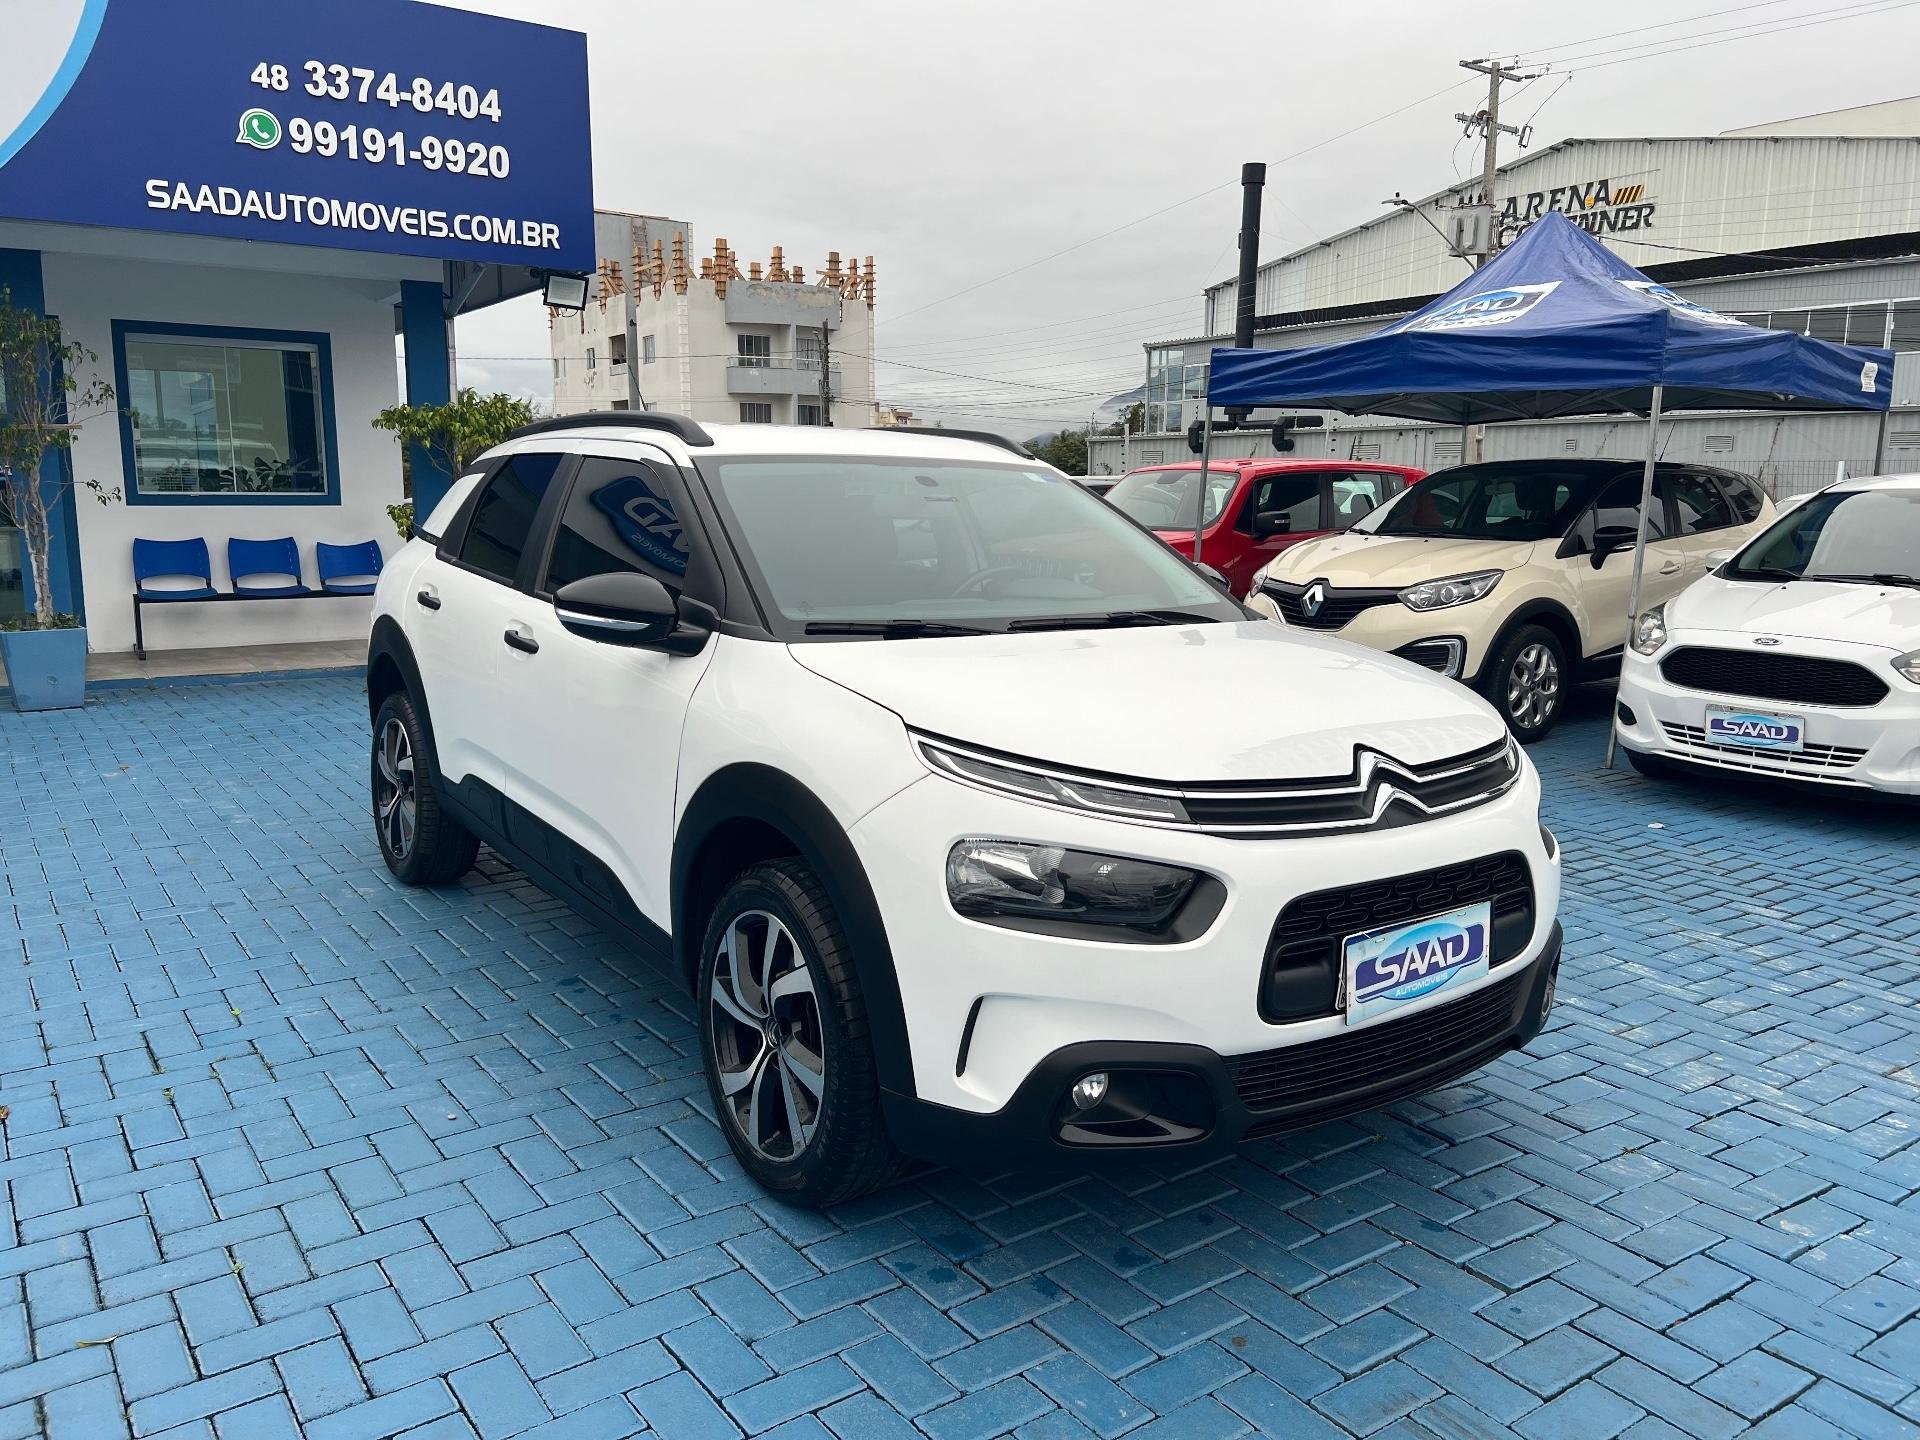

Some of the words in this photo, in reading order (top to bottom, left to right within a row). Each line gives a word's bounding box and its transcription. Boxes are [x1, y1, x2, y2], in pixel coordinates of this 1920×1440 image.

[250, 62, 289, 91] 48
[303, 60, 502, 122] 3374-8404
[288, 117, 510, 179] 99191-9920
[145, 179, 561, 249] SAADAUTOMOVEIS.COM.BR
[1501, 179, 1612, 226] ARENA
[1722, 720, 1788, 740] SAAD
[1375, 928, 1470, 986] SAAD
